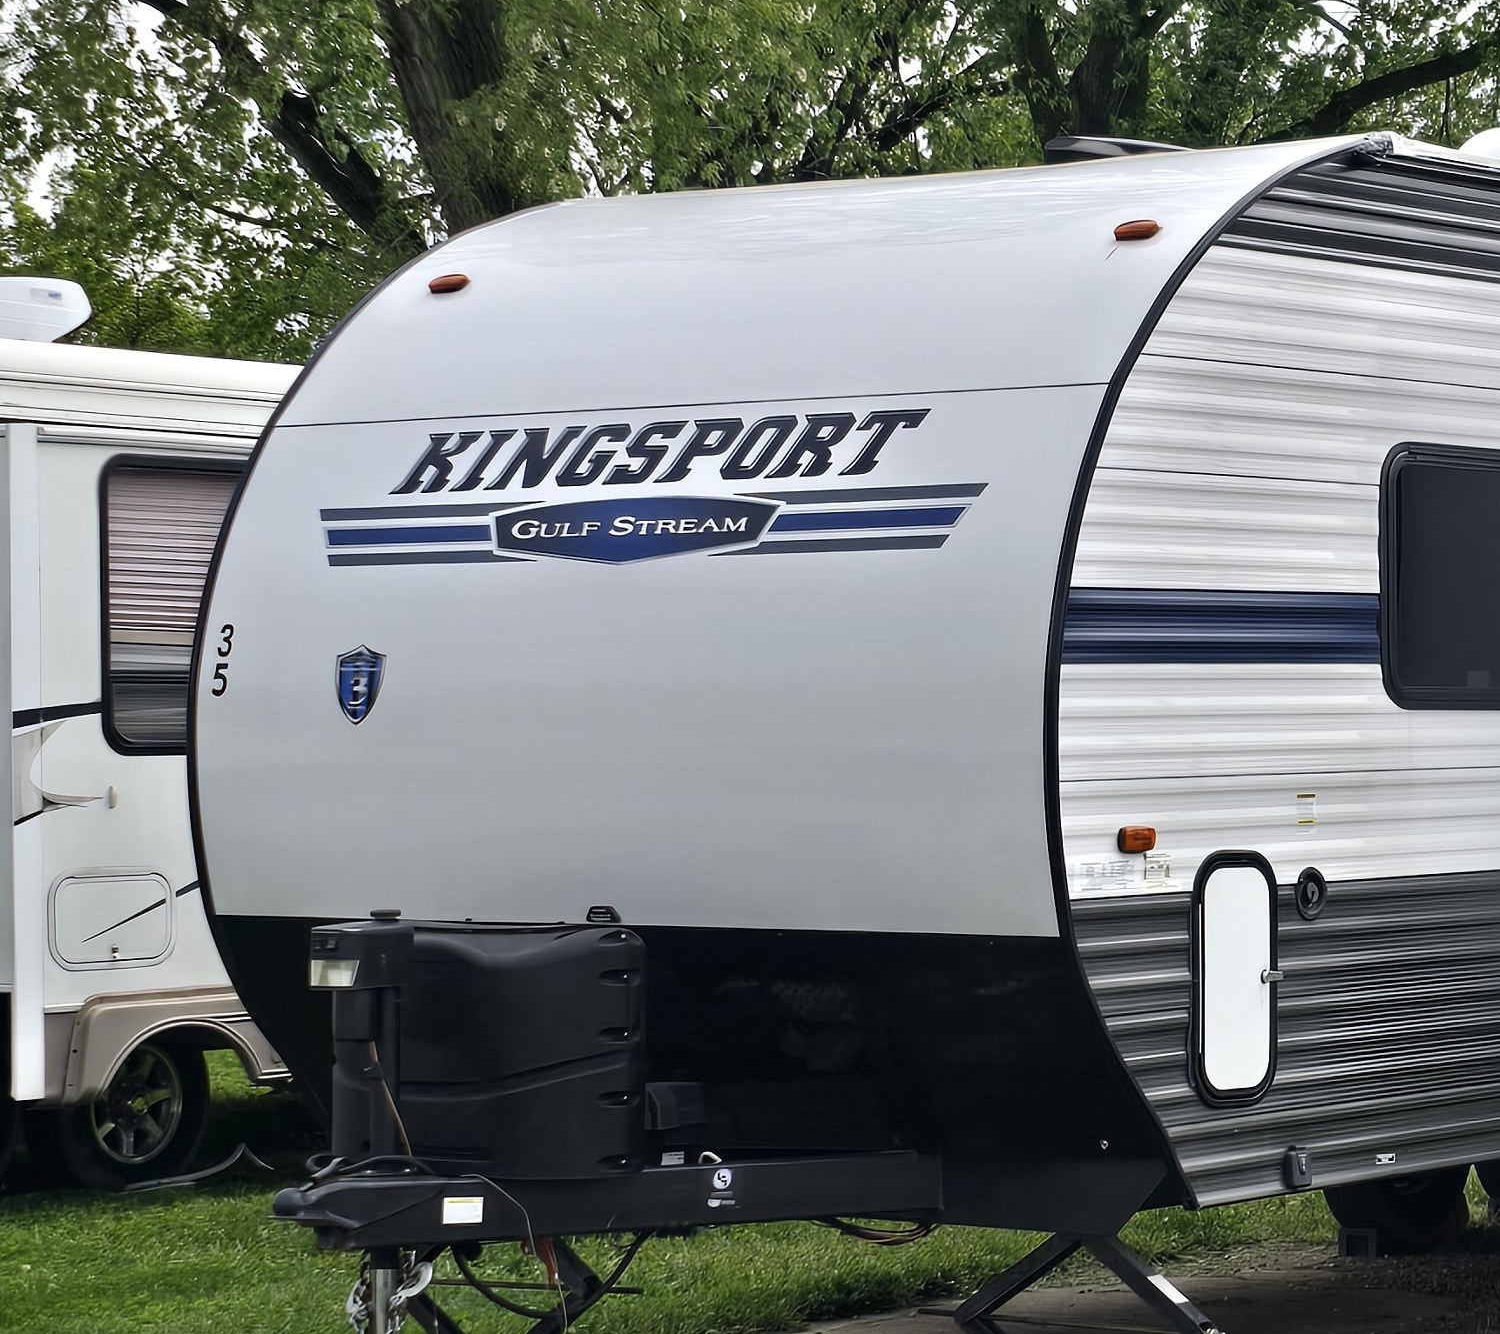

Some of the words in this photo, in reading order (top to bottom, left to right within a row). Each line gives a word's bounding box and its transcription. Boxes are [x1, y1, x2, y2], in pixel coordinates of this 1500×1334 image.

[388, 408, 932, 495] KINGSPORT
[511, 520, 601, 540] GULF
[608, 516, 748, 536] STREAM
